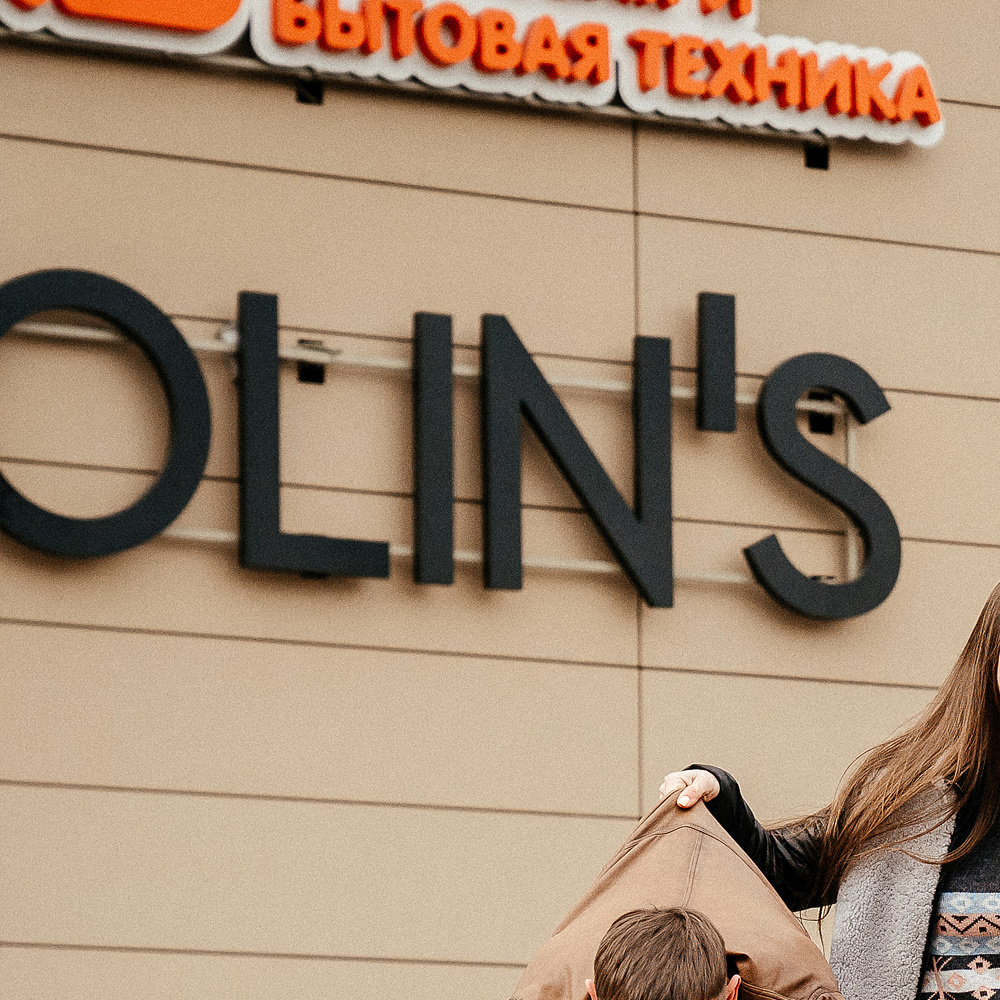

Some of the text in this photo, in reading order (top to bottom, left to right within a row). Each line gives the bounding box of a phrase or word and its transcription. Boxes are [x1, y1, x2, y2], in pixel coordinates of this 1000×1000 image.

[269, 0, 941, 128] БЫТОВАЯ ТЕХНИКА
[0, 268, 902, 620] OLIN'S
